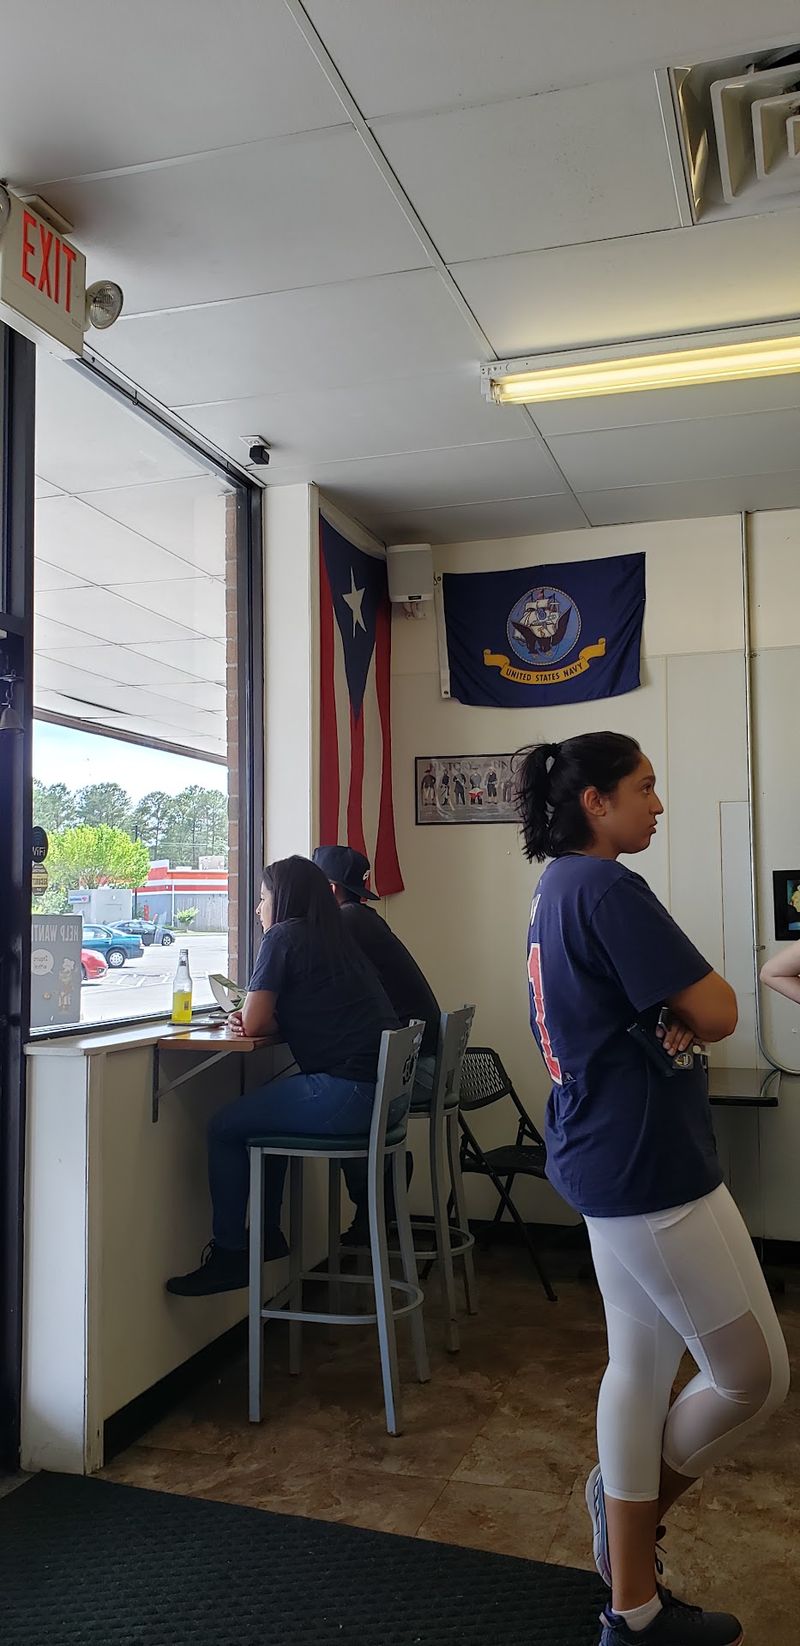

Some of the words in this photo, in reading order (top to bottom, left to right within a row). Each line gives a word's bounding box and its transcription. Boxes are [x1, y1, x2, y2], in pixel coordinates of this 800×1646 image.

[22, 210, 77, 313] EXIT
[505, 668, 532, 681] UNITED
[535, 672, 560, 682] STATES
[563, 662, 583, 678] NAVY
